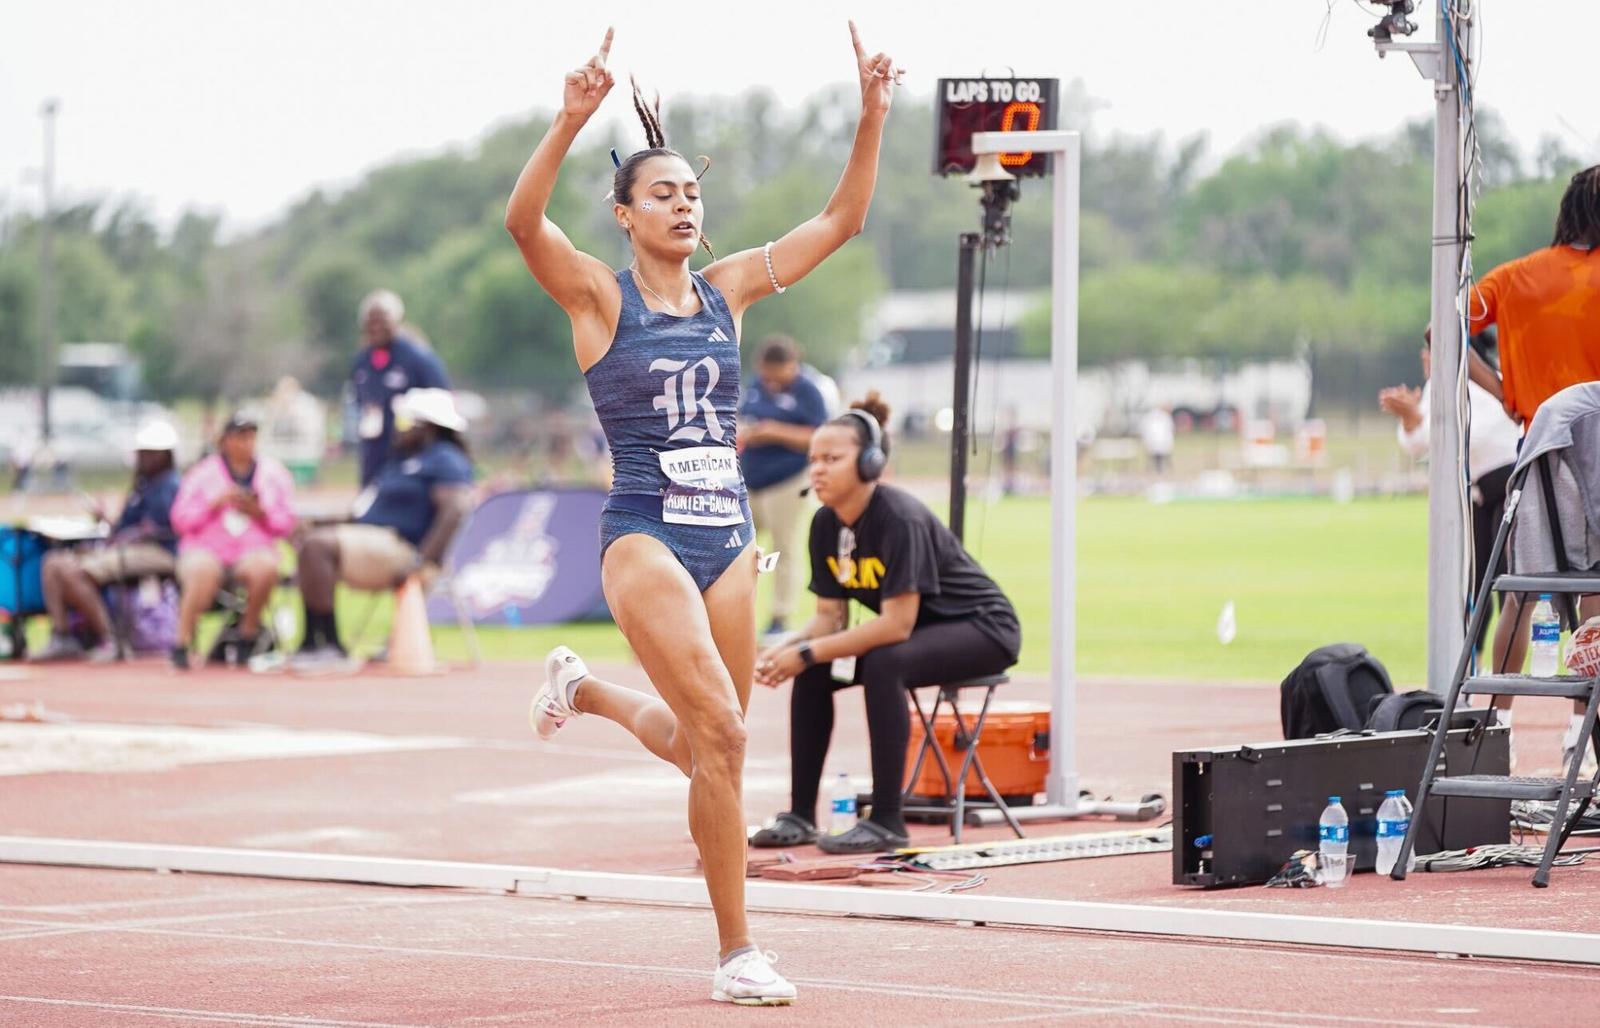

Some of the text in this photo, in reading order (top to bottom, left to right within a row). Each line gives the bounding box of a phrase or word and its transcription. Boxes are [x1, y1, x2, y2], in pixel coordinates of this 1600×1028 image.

[946, 81, 1041, 103] LAPS TO GO
[998, 101, 1041, 165] 0
[668, 458, 733, 474] AMERICAN
